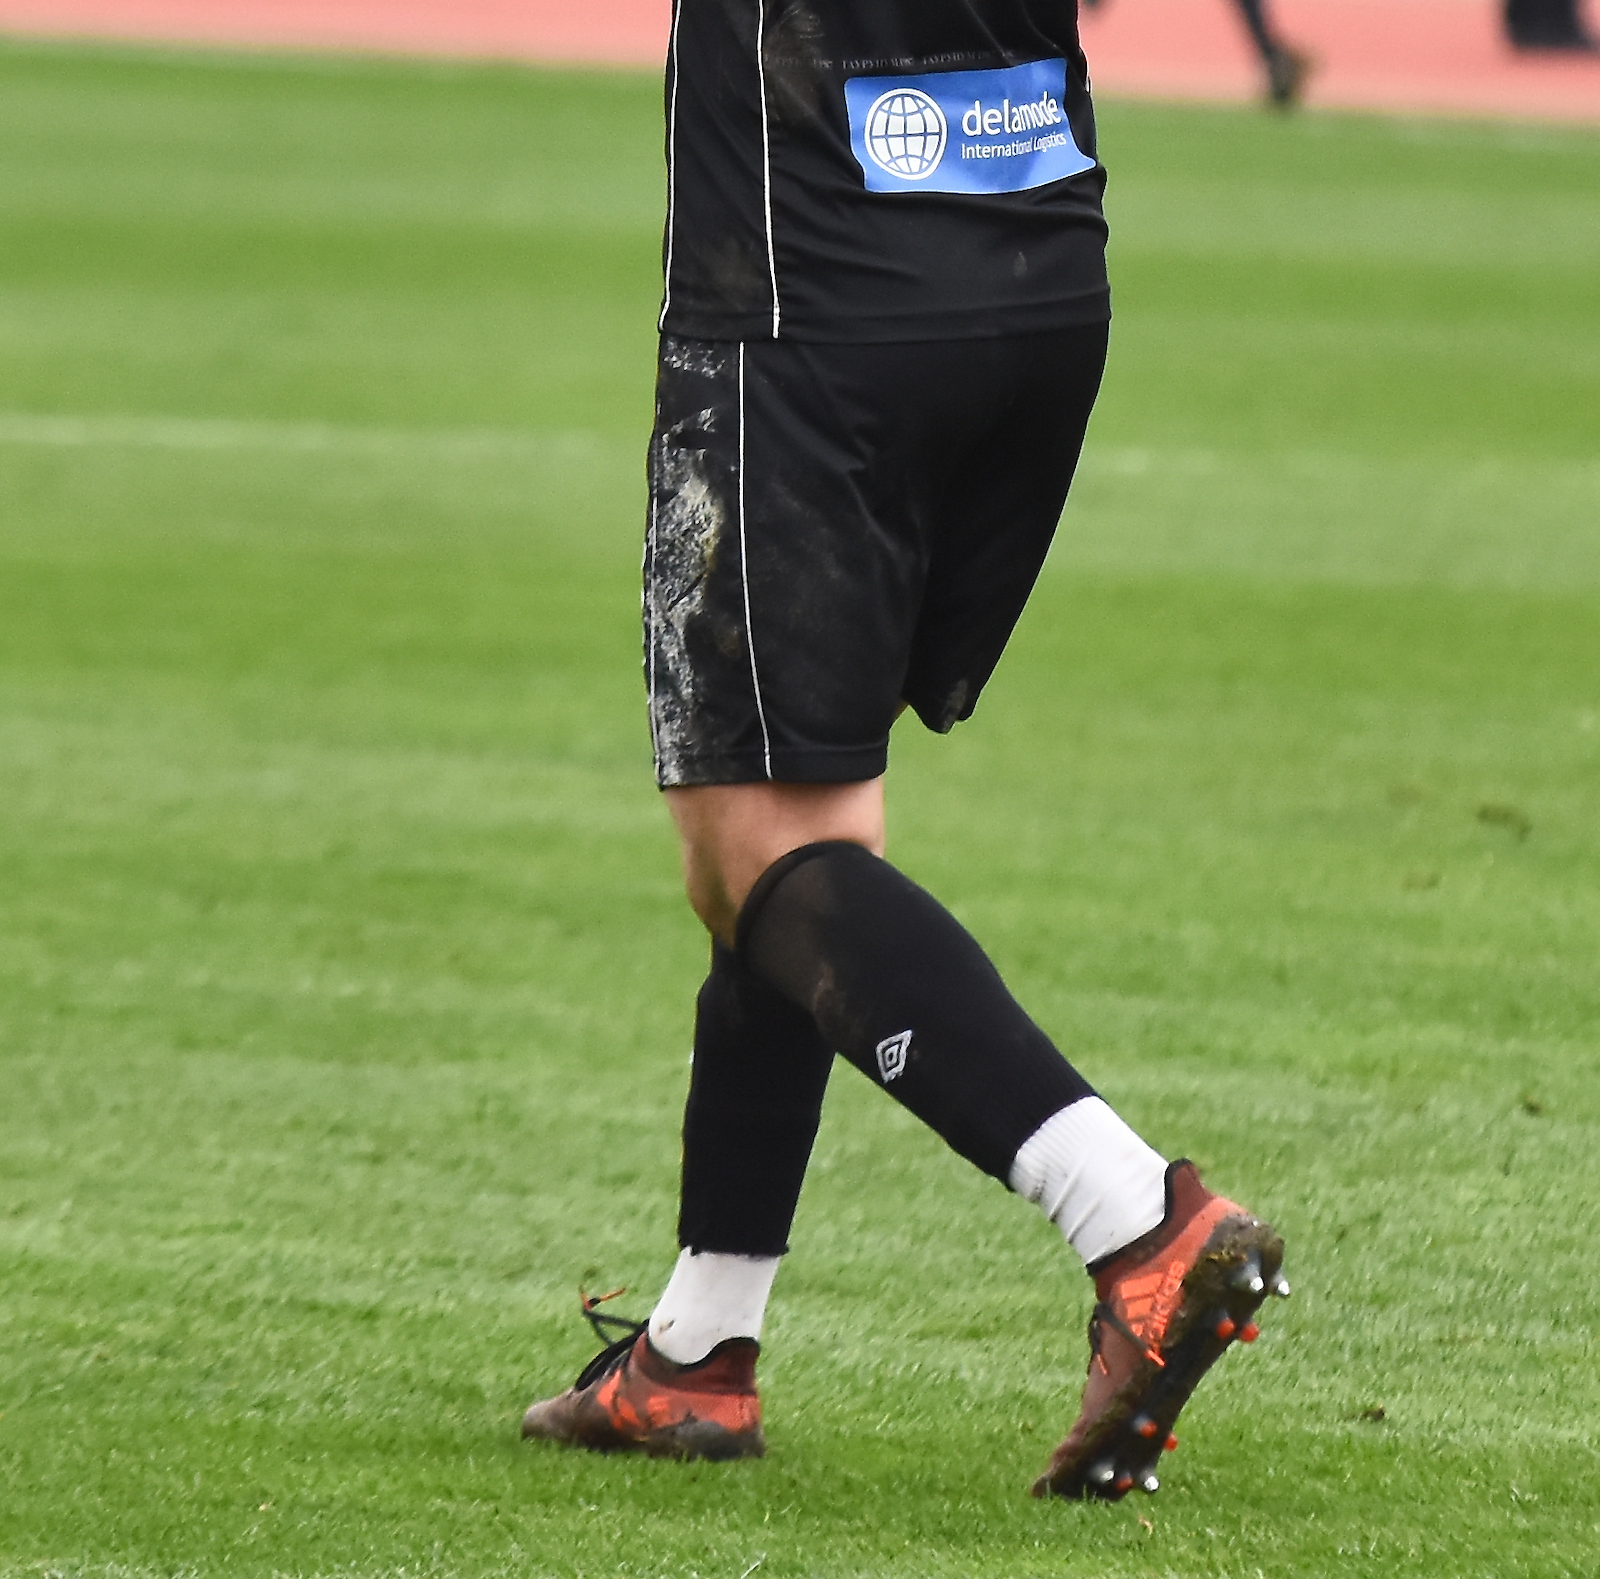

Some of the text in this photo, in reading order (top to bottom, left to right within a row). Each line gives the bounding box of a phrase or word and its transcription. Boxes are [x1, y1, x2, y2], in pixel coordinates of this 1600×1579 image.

[962, 90, 1062, 136] delamode
[961, 131, 1067, 159] International Logistics
